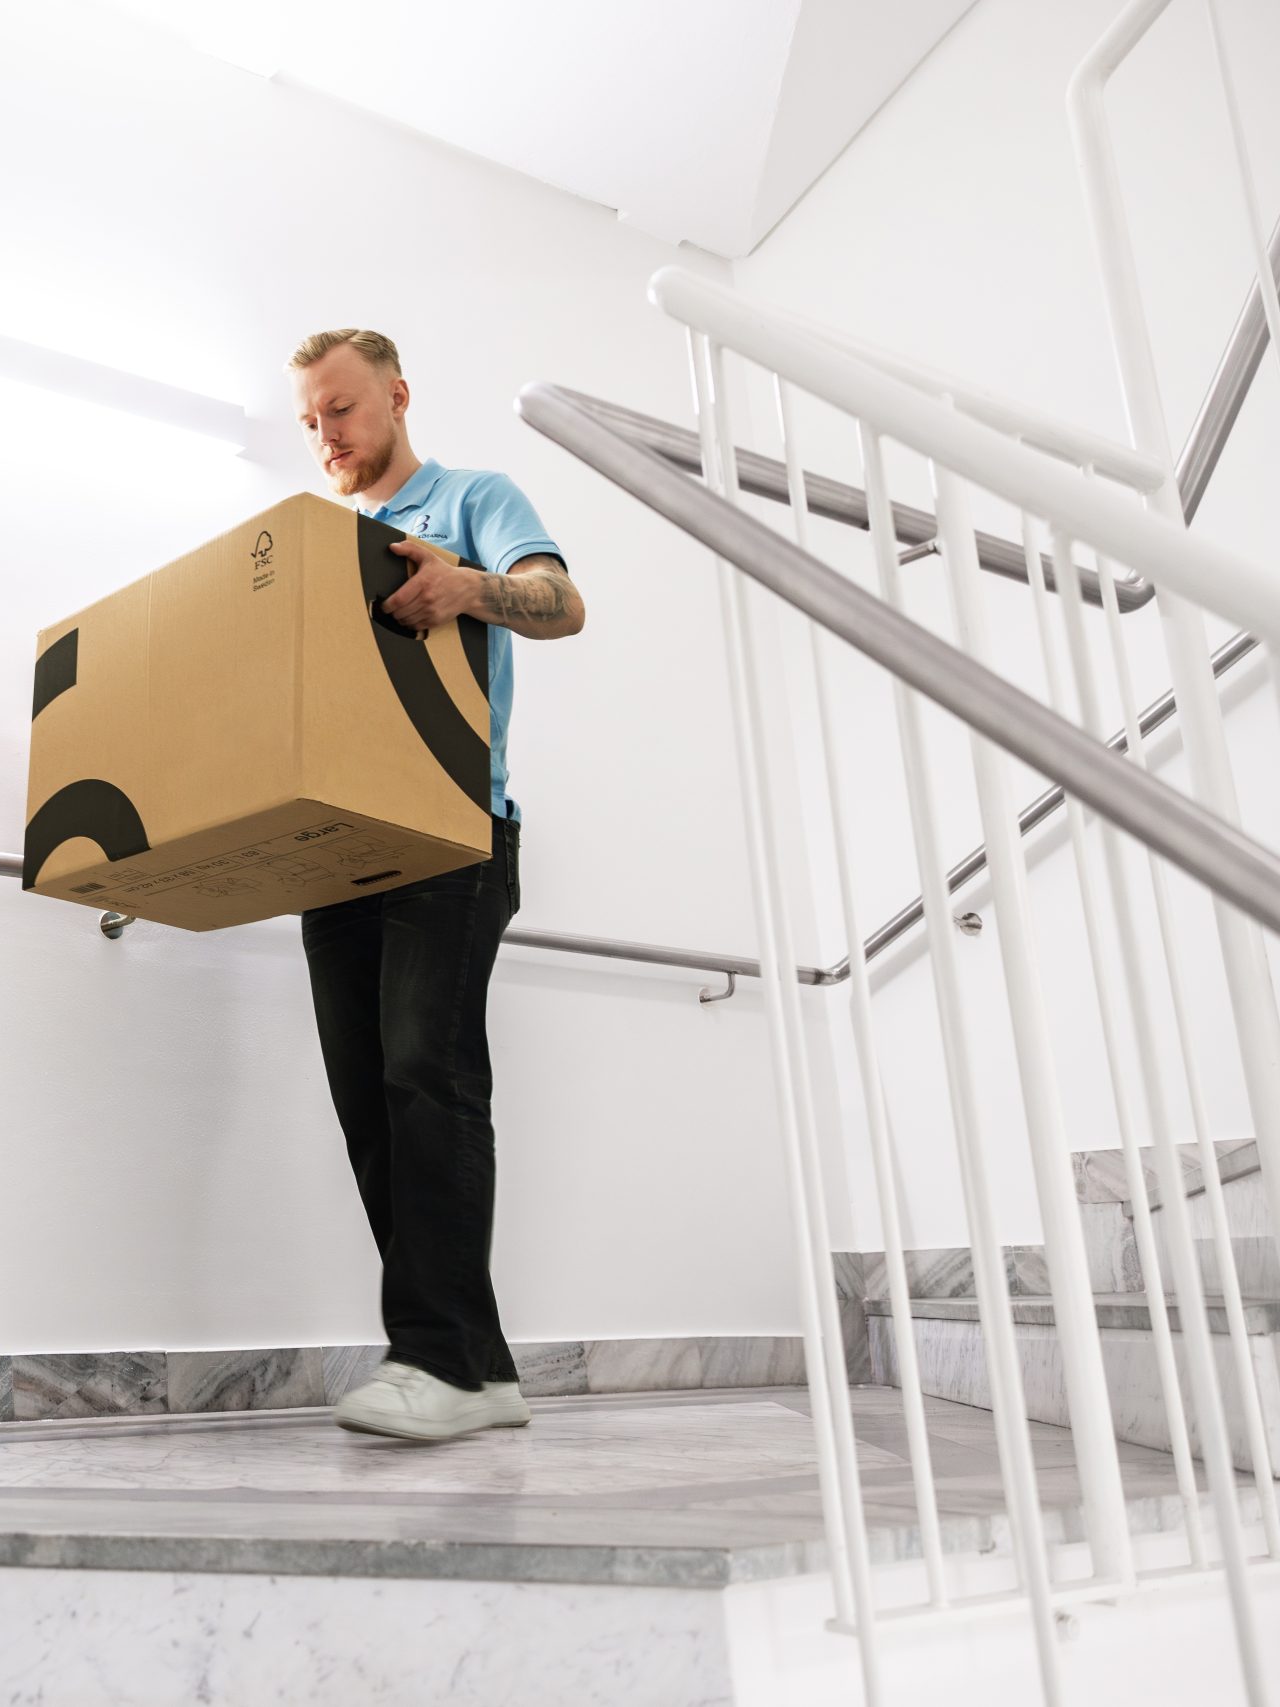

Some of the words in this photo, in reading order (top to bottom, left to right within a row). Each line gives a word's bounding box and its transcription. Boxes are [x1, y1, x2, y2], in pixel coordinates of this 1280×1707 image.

[254, 555, 274, 570] FSC
[253, 572, 269, 584] Made
[253, 578, 276, 592] Sweden
[294, 822, 355, 842] Large
